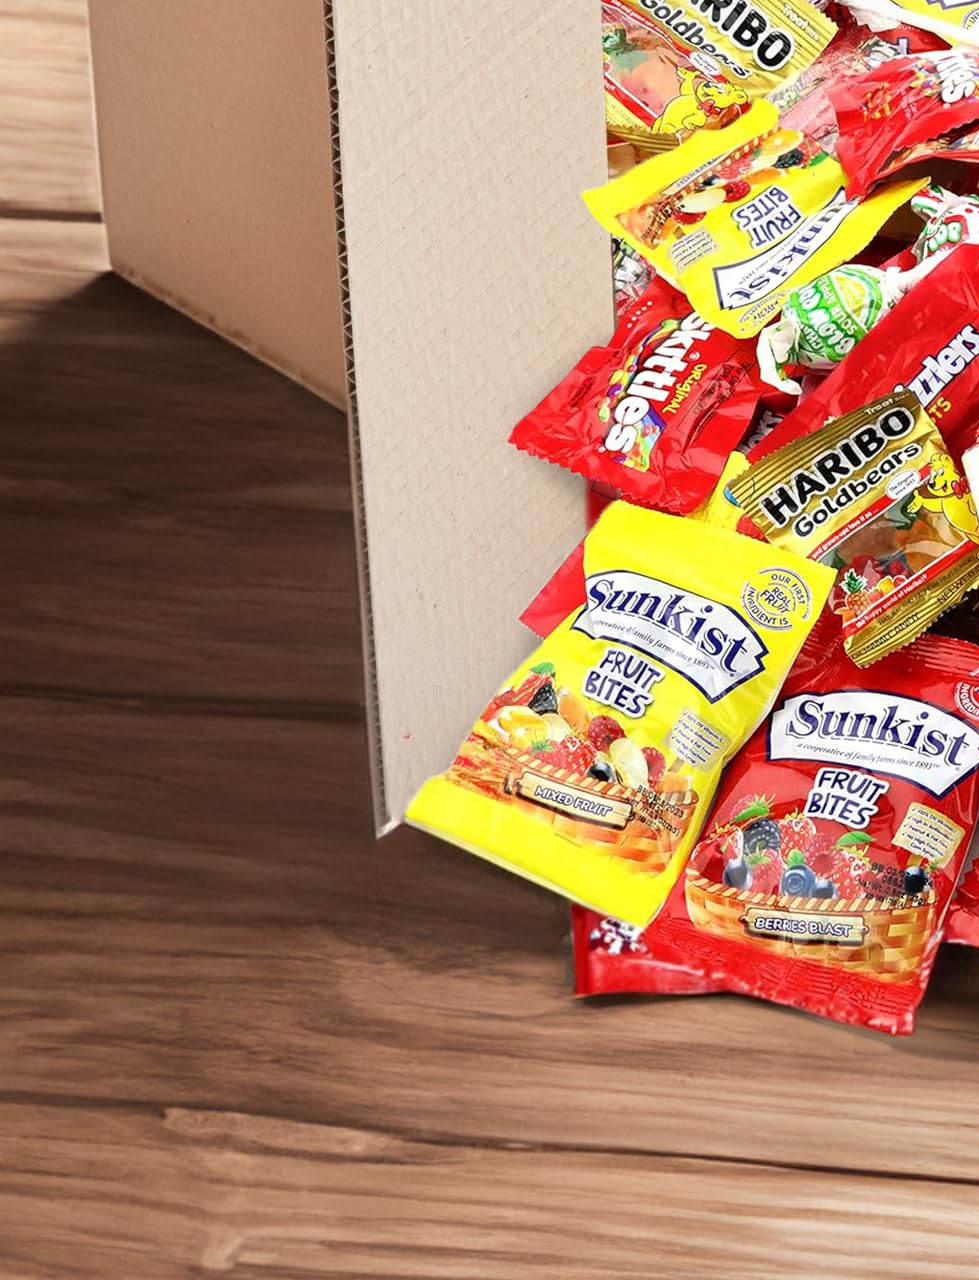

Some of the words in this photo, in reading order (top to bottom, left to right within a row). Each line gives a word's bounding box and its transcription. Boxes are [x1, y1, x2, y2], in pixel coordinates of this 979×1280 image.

[782, 4, 807, 28] Treat
[734, 188, 789, 227] BITES
[754, 207, 803, 246] FRUIT
[730, 197, 850, 300] unkist
[604, 310, 716, 454] Skittles
[863, 397, 893, 417] Treat
[762, 408, 913, 525] HARIBO
[794, 444, 919, 537] Goldbears
[760, 589, 790, 614] FRUIT
[770, 573, 792, 585] OUR
[791, 578, 806, 605] FIRST
[770, 586, 792, 607] REAL
[587, 578, 749, 676] Sunkist
[779, 616, 789, 626] IS
[653, 635, 676, 654] farms
[675, 649, 693, 664] since
[599, 648, 664, 688] FRUIT
[584, 670, 653, 715] BITES
[786, 699, 969, 767] Sunkist
[802, 743, 844, 757] cooperative
[844, 750, 853, 759] of
[851, 750, 876, 765] family
[876, 753, 895, 766] farms
[896, 757, 914, 768] since
[534, 785, 573, 807] MIXED
[573, 795, 613, 817] FRUIT
[817, 770, 886, 802] FRUIT
[807, 792, 878, 826] BITES
[754, 916, 807, 934] BERRIES
[807, 920, 854, 936] BLAST
